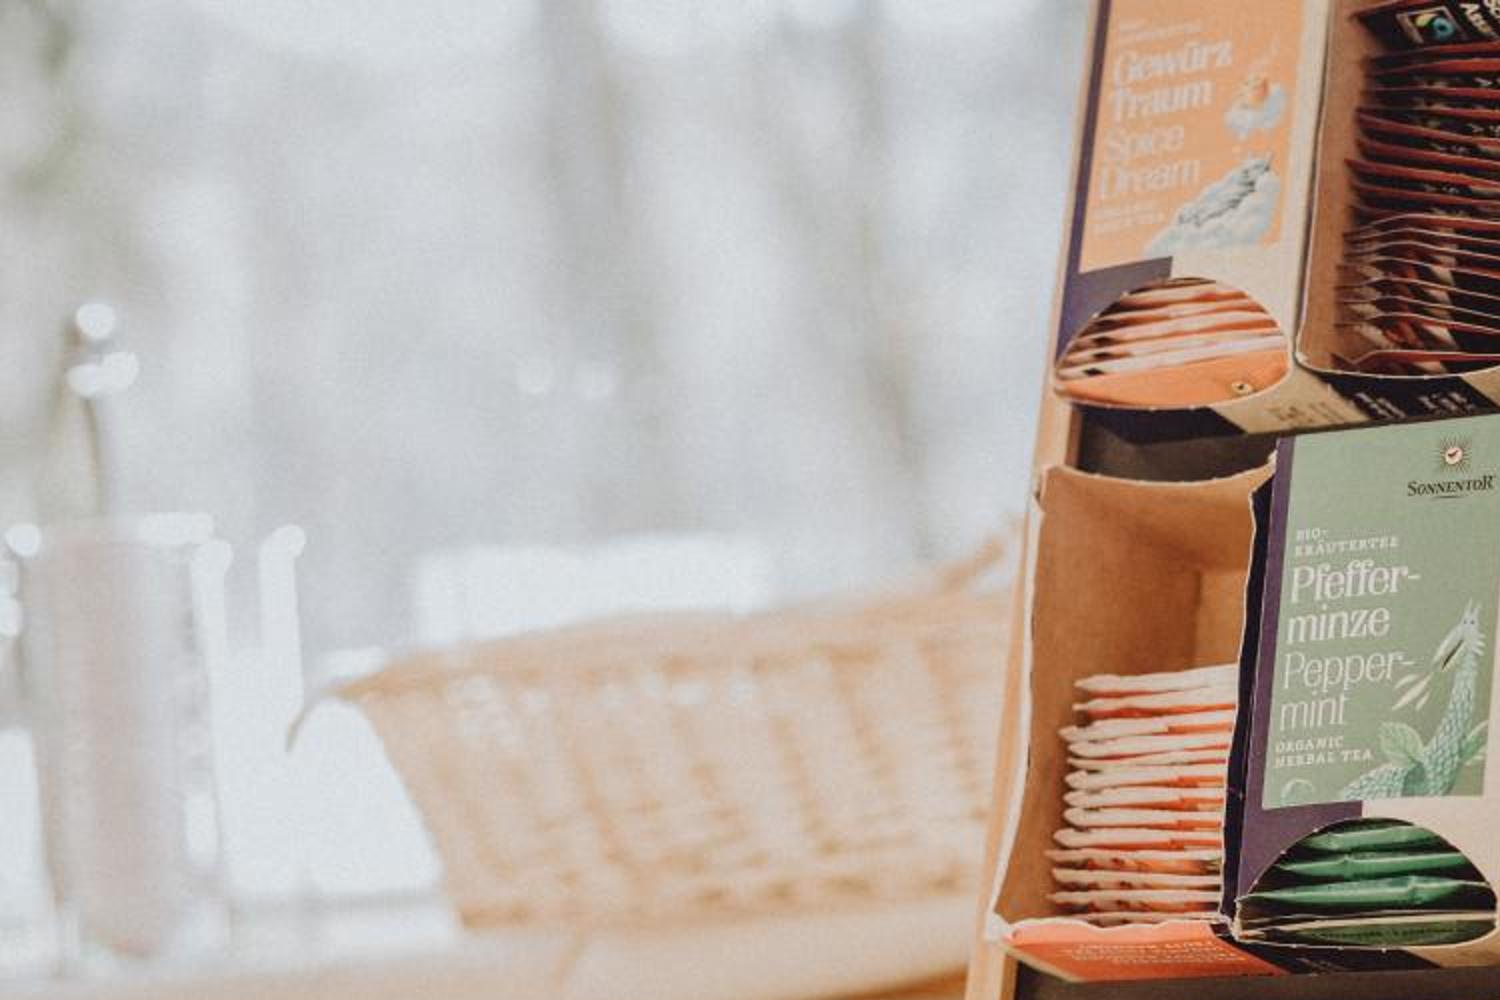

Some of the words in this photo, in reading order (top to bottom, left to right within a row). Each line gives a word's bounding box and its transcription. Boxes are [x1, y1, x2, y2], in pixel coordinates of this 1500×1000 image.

[1111, 81, 1214, 122] Traum
[1407, 474, 1495, 497] SONNENTOR
[1289, 559, 1421, 604] Pfeffer-
[1286, 603, 1391, 645] minze
[1283, 650, 1416, 692] Pepper-
[1279, 689, 1350, 731] mint
[1275, 735, 1344, 753] ORGANIC
[1275, 752, 1337, 769] HERBAL
[1341, 748, 1374, 762] TEA
